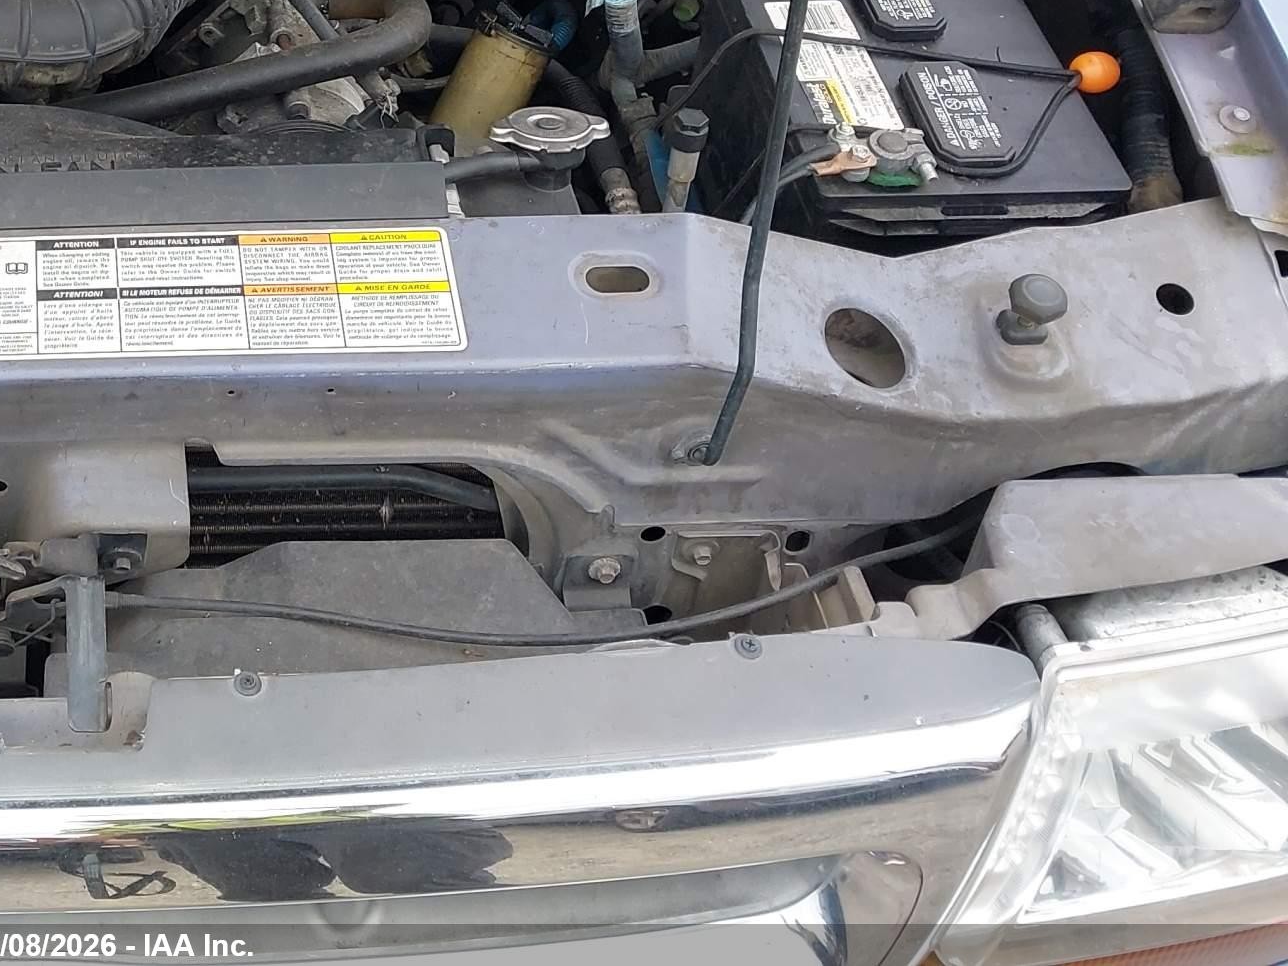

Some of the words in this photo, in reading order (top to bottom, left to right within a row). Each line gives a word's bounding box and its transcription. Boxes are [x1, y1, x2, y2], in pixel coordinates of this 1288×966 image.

[916, 72, 938, 101] POISON
[806, 83, 837, 124] Duralast
[934, 107, 956, 139] DANGER
[54, 290, 103, 298] ATTENTION!
